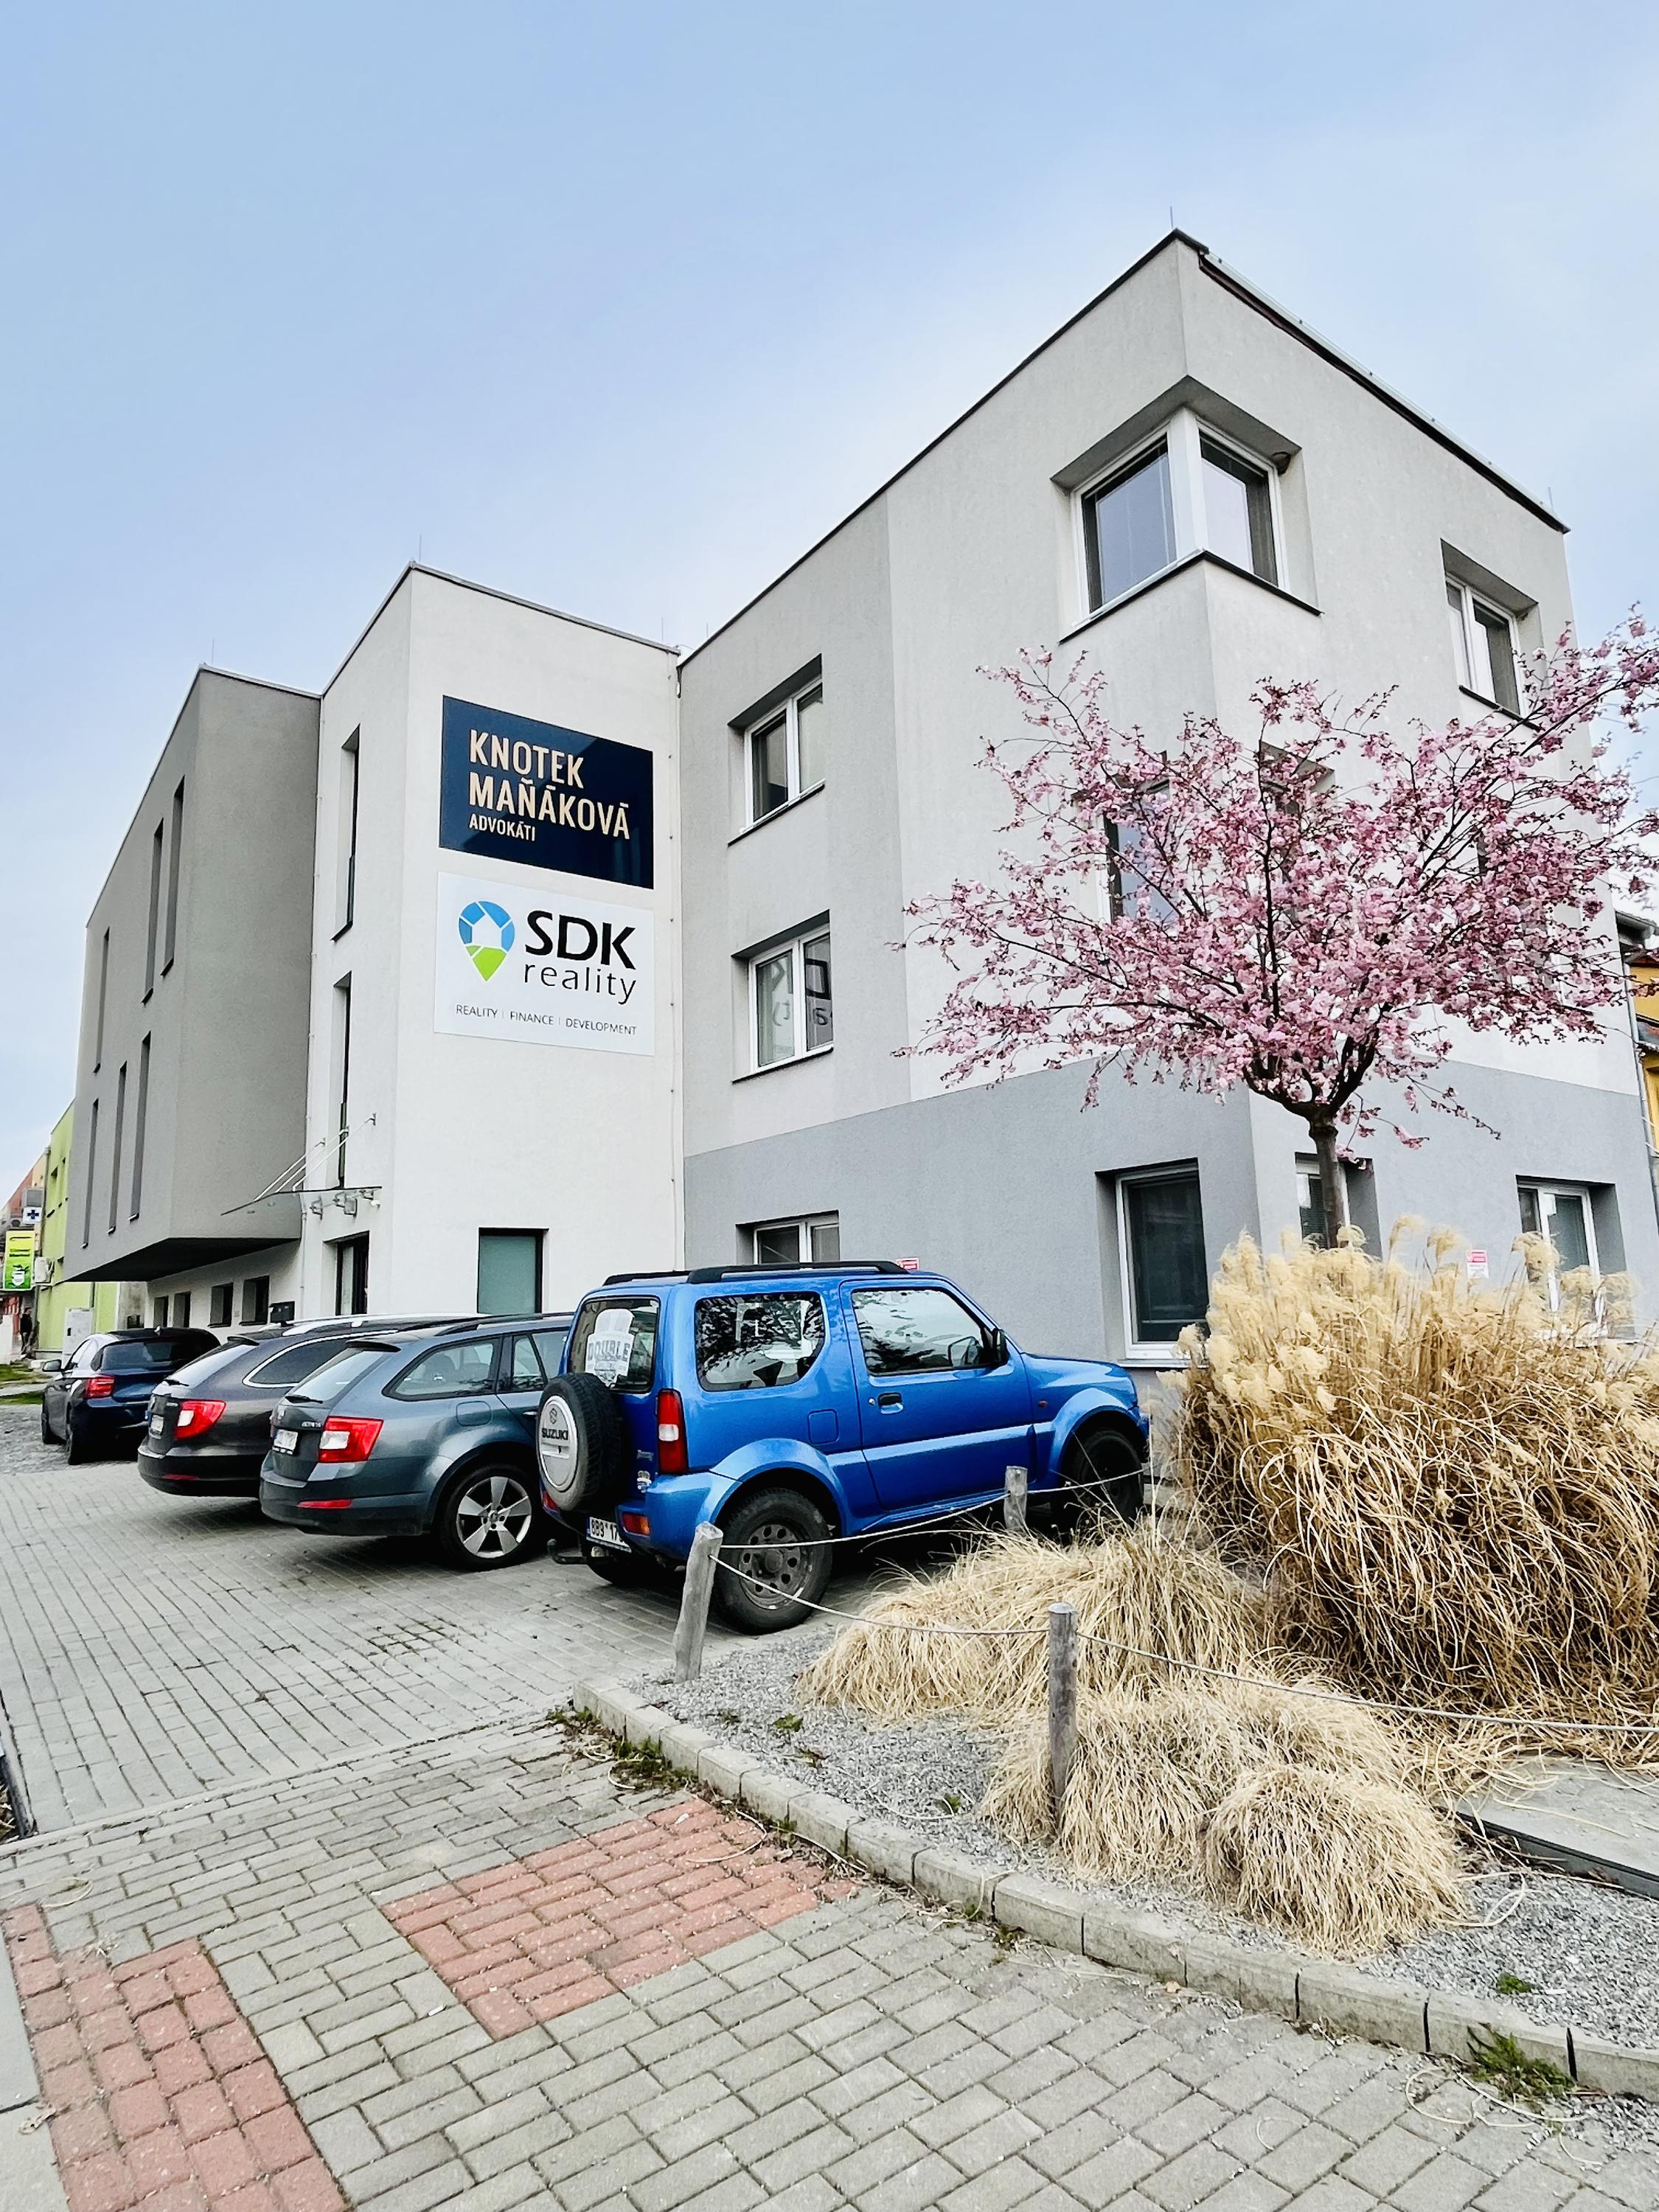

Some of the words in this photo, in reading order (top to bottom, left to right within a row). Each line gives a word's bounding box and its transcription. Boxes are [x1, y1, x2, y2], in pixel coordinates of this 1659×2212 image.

[470, 728, 584, 789] KNOTEK
[469, 813, 536, 842] ADVOKÁTI
[524, 909, 636, 970] SDK
[524, 963, 637, 1006] reality
[456, 1004, 498, 1019] REALITY
[509, 1010, 554, 1026] FINANCE
[565, 1018, 637, 1035] DEVELOPMENT
[541, 1427, 568, 1441] SUZUKI
